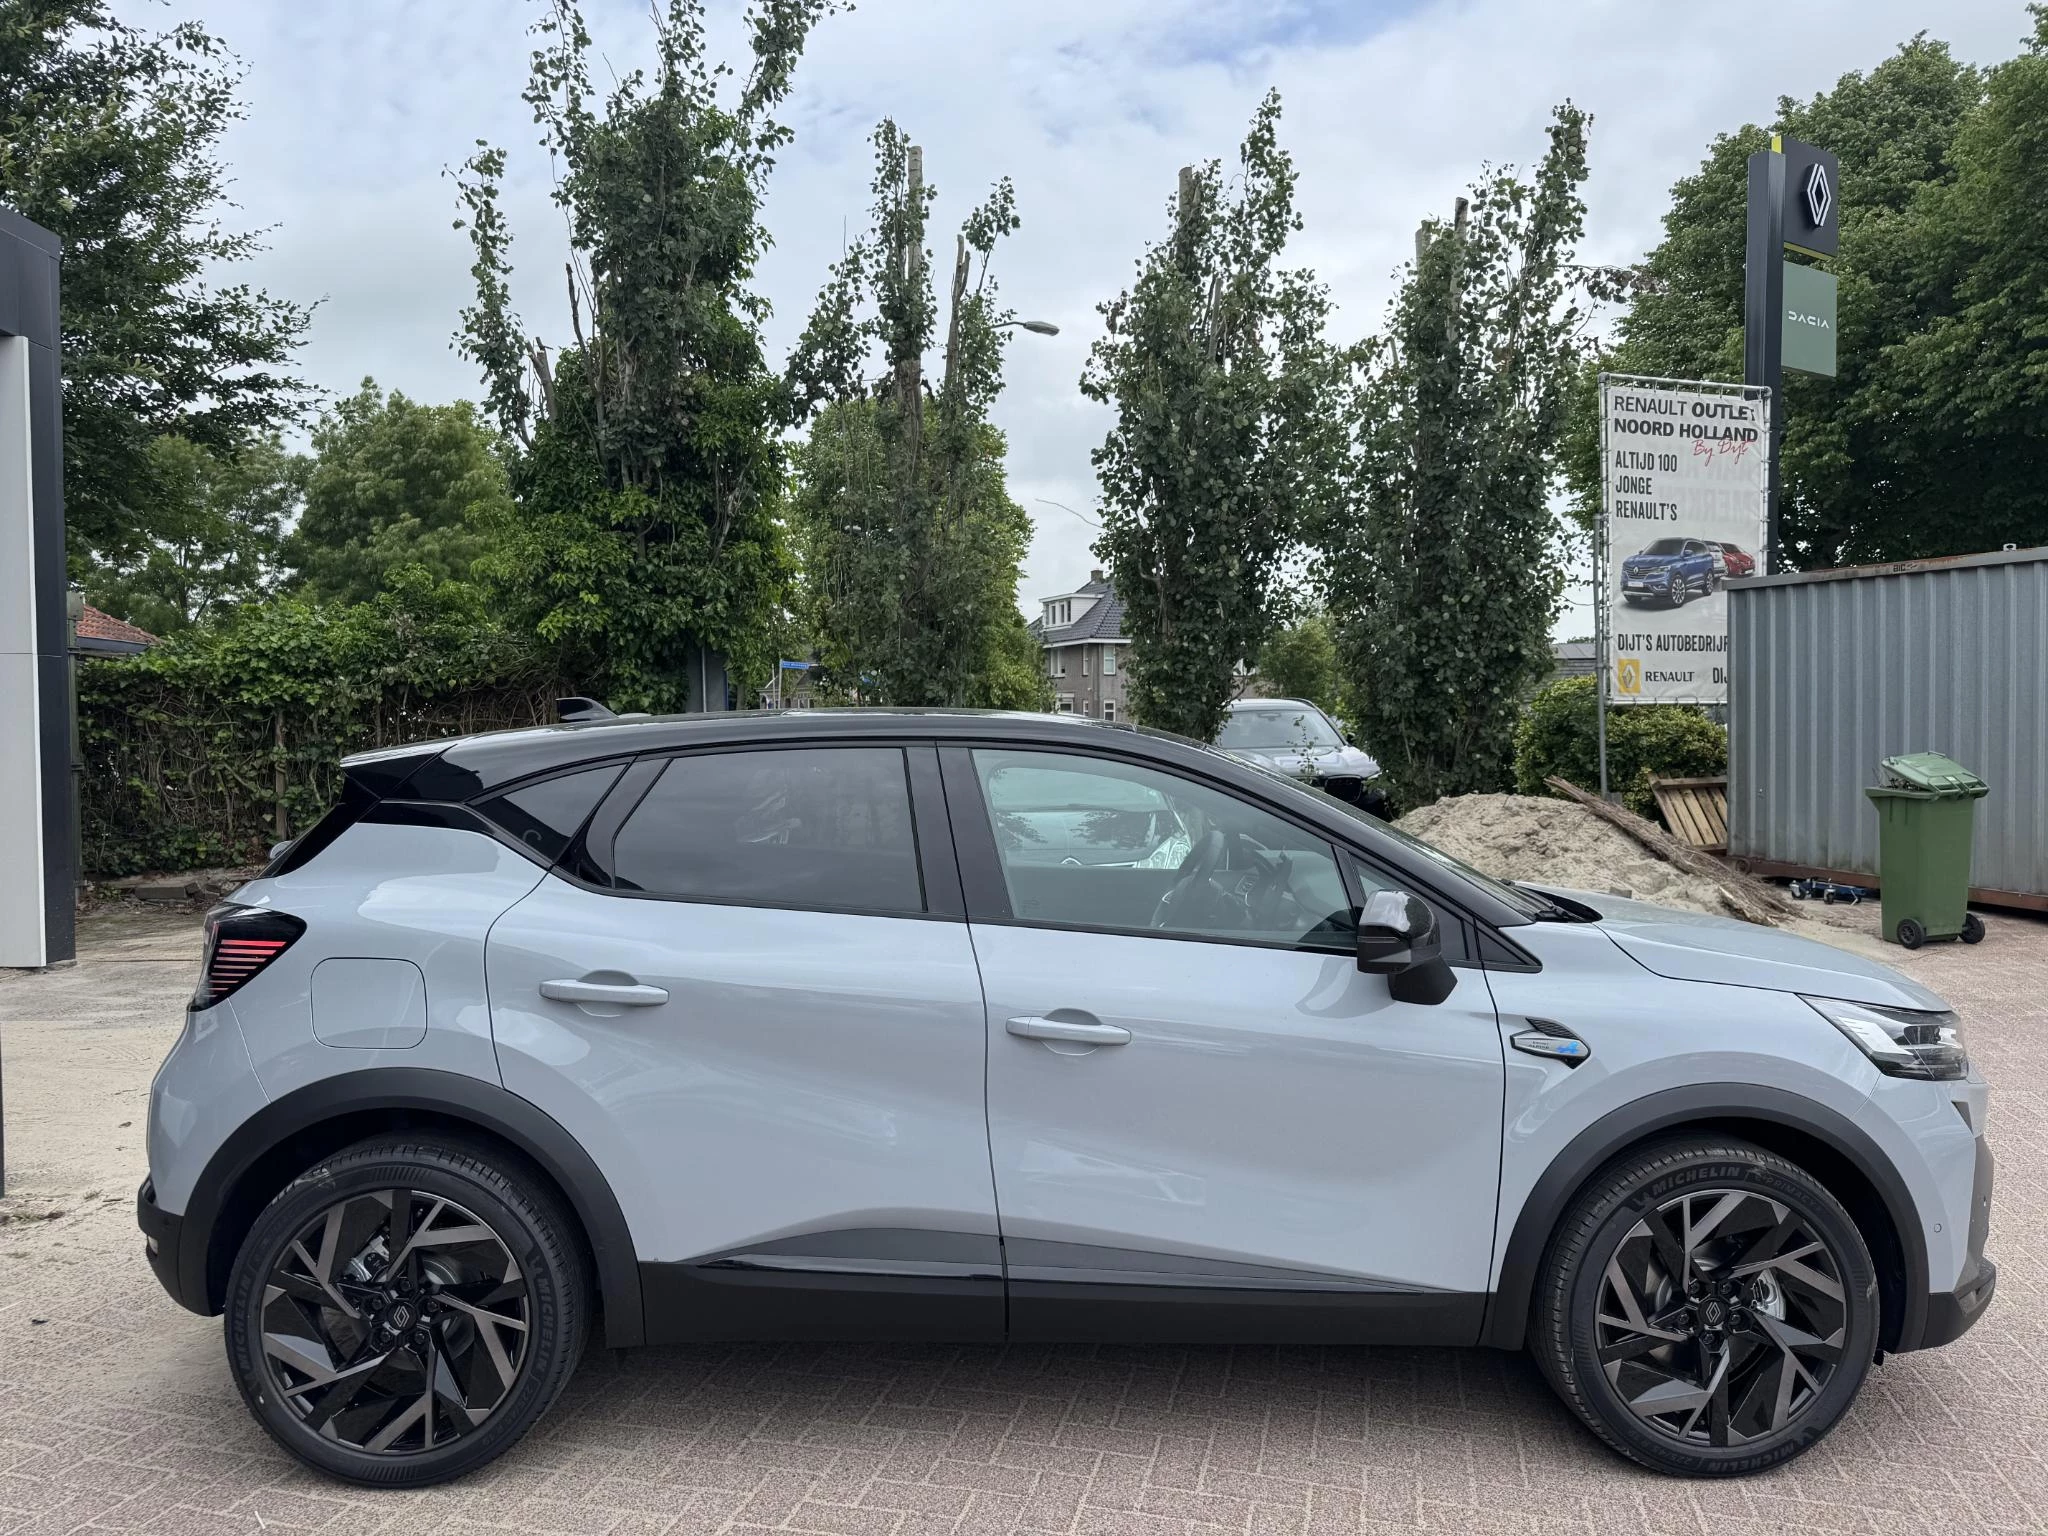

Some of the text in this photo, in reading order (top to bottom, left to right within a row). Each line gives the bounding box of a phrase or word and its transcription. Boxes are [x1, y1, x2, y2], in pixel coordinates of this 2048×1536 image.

[1788, 310, 1830, 329] DACIA
[1614, 395, 1687, 417] RENAULT
[1614, 418, 1758, 442] NOORD HOLLAND
[1615, 450, 1678, 472] ALTIJD 100
[1692, 439, 1714, 467] By
[1615, 475, 1652, 495] JONGE
[1615, 500, 1678, 521] RENAULT'S
[1617, 633, 1728, 652] DIJT'S AUTOBEDRIJF
[1645, 671, 1695, 682] RENAULT
[1653, 1166, 1740, 1194] MICHELIN
[1707, 1441, 1795, 1472] MICHELIN
